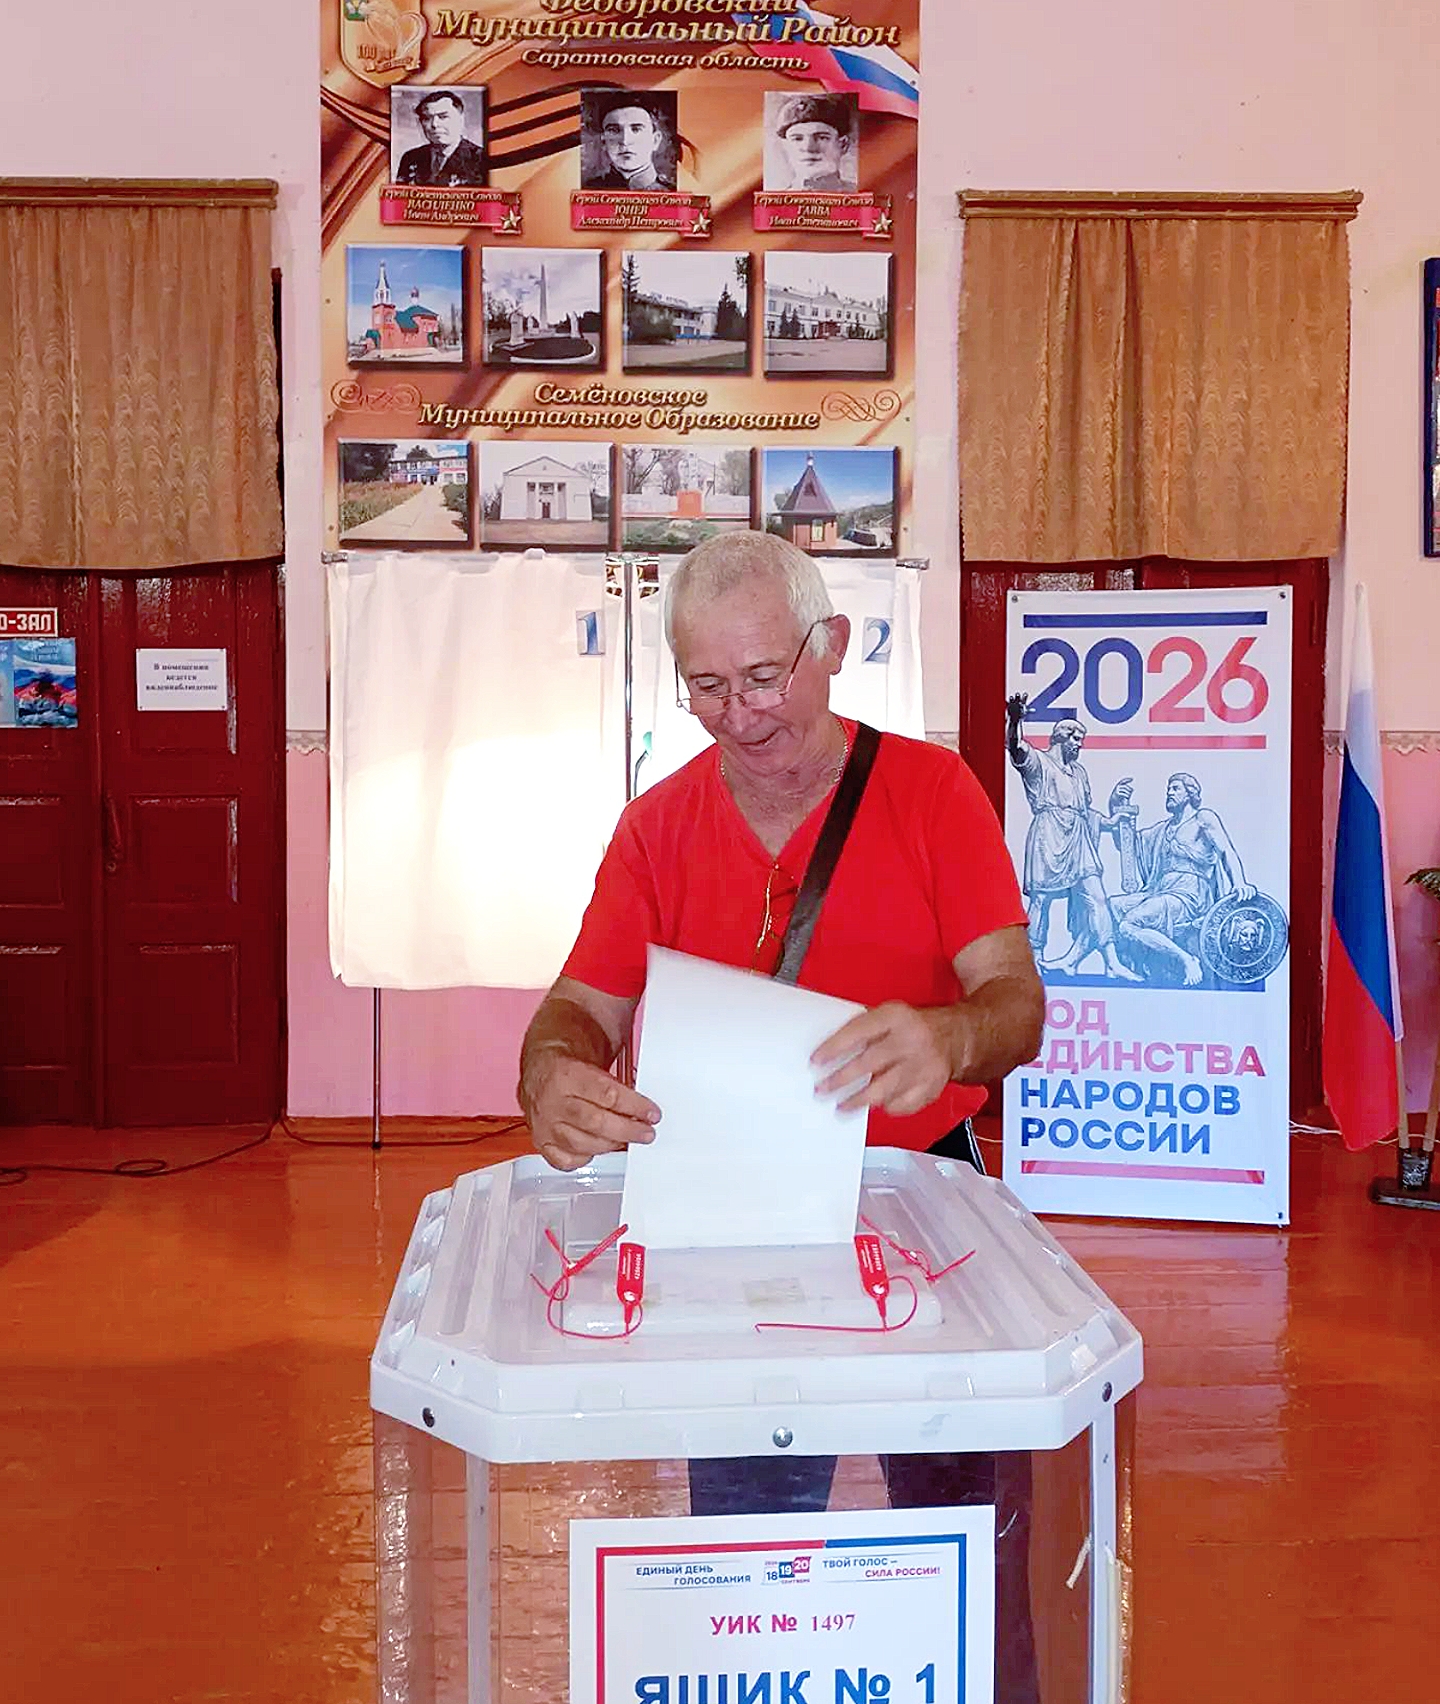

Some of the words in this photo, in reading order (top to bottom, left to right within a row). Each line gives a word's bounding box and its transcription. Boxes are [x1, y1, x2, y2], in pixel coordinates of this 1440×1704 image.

[433, 9, 770, 46] Муниципальный
[780, 14, 901, 46] Район
[520, 47, 694, 70] Саратовская
[700, 50, 811, 70] область
[534, 381, 707, 407] Семёновское
[418, 403, 641, 431] Муниципальное
[645, 405, 821, 434] Образование
[577, 611, 605, 655] 1
[865, 618, 891, 662] 2
[1021, 636, 1268, 724] 2026
[1045, 999, 1109, 1035] ОД
[1022, 1039, 1266, 1076] ДИНСТВА
[1020, 1078, 1241, 1118] НАРОДОВ
[1020, 1117, 1211, 1154] РОССИИ
[636, 1566, 683, 1576] ЕДИНЫЙ
[685, 1564, 714, 1575] ДЕНЬ
[766, 1571, 778, 1581] 18
[781, 1565, 792, 1575] 19
[794, 1560, 809, 1570] 20
[822, 1557, 850, 1568] ТВОЙ
[853, 1557, 888, 1567] ГОЛОС
[865, 1568, 893, 1578] СИЛА
[895, 1567, 941, 1577] РОССИИ!
[674, 1574, 751, 1586] ГОЛОСОВАНИЯ
[710, 1614, 761, 1635] УИК
[771, 1614, 797, 1633] №
[811, 1613, 856, 1632] 1497
[835, 1667, 891, 1704] №
[915, 1663, 935, 1703] 1
